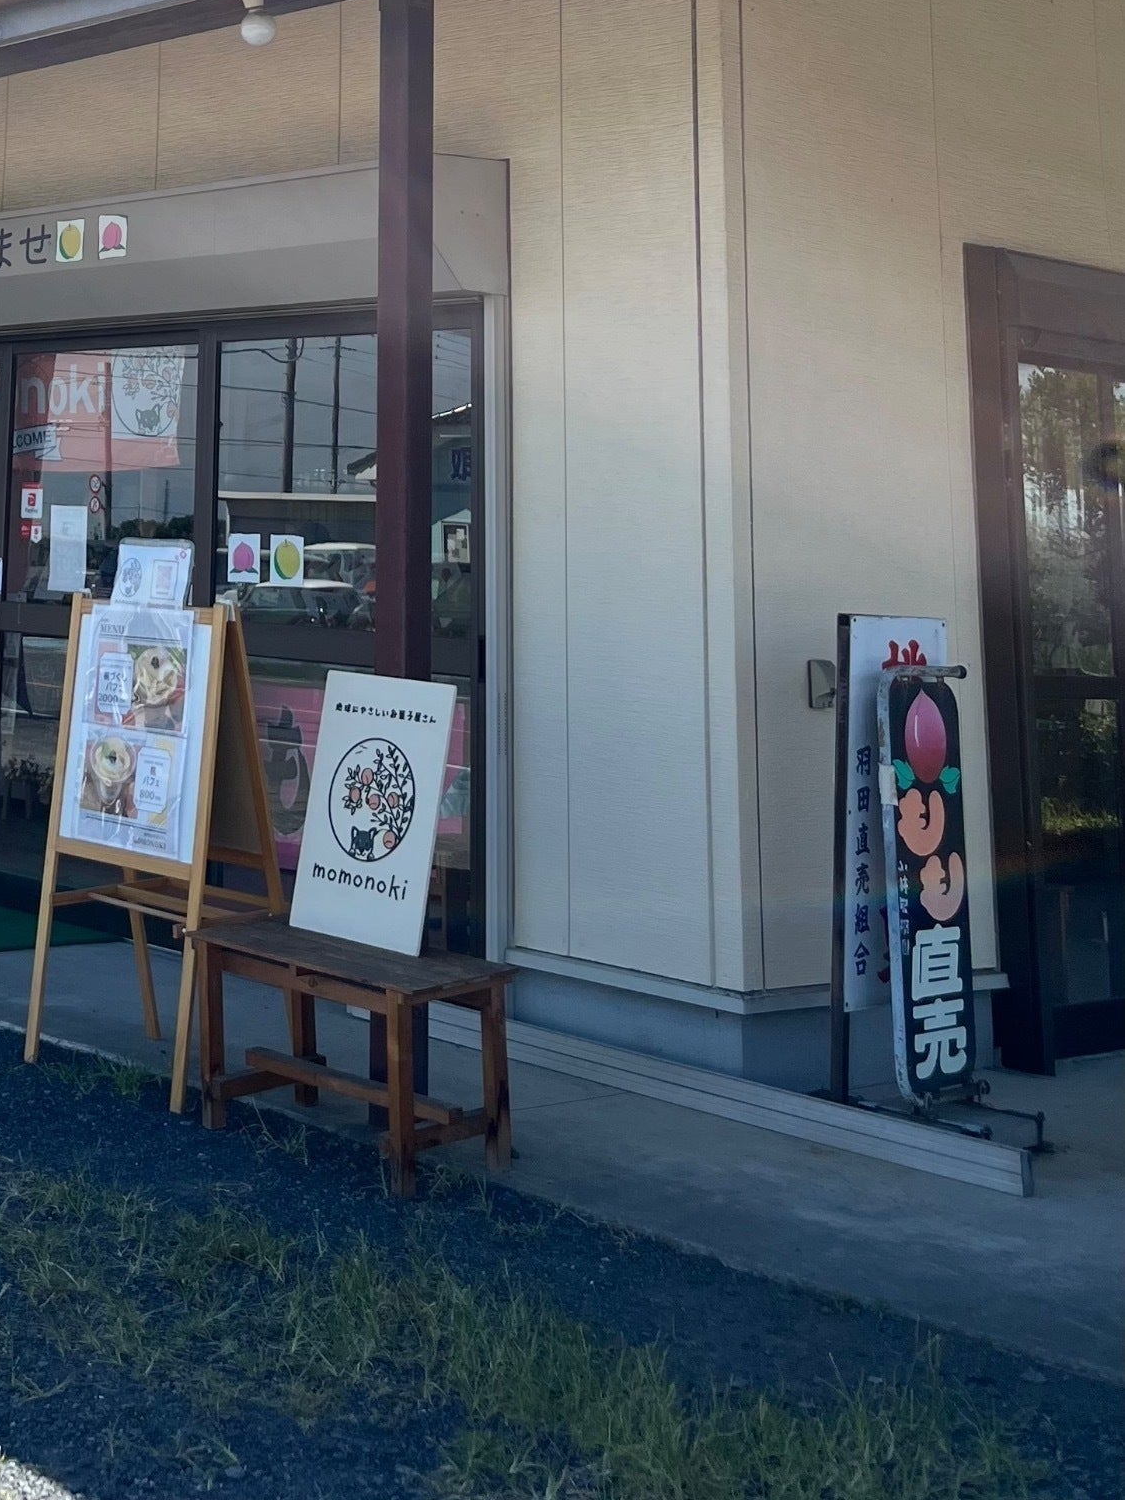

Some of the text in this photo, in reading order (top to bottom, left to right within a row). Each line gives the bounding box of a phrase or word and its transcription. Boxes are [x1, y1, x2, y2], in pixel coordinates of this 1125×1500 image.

[13, 430, 52, 449] COME
[100, 623, 125, 635] MENU
[853, 745, 872, 976] 羽田直売組合
[312, 862, 409, 901] momonoki
